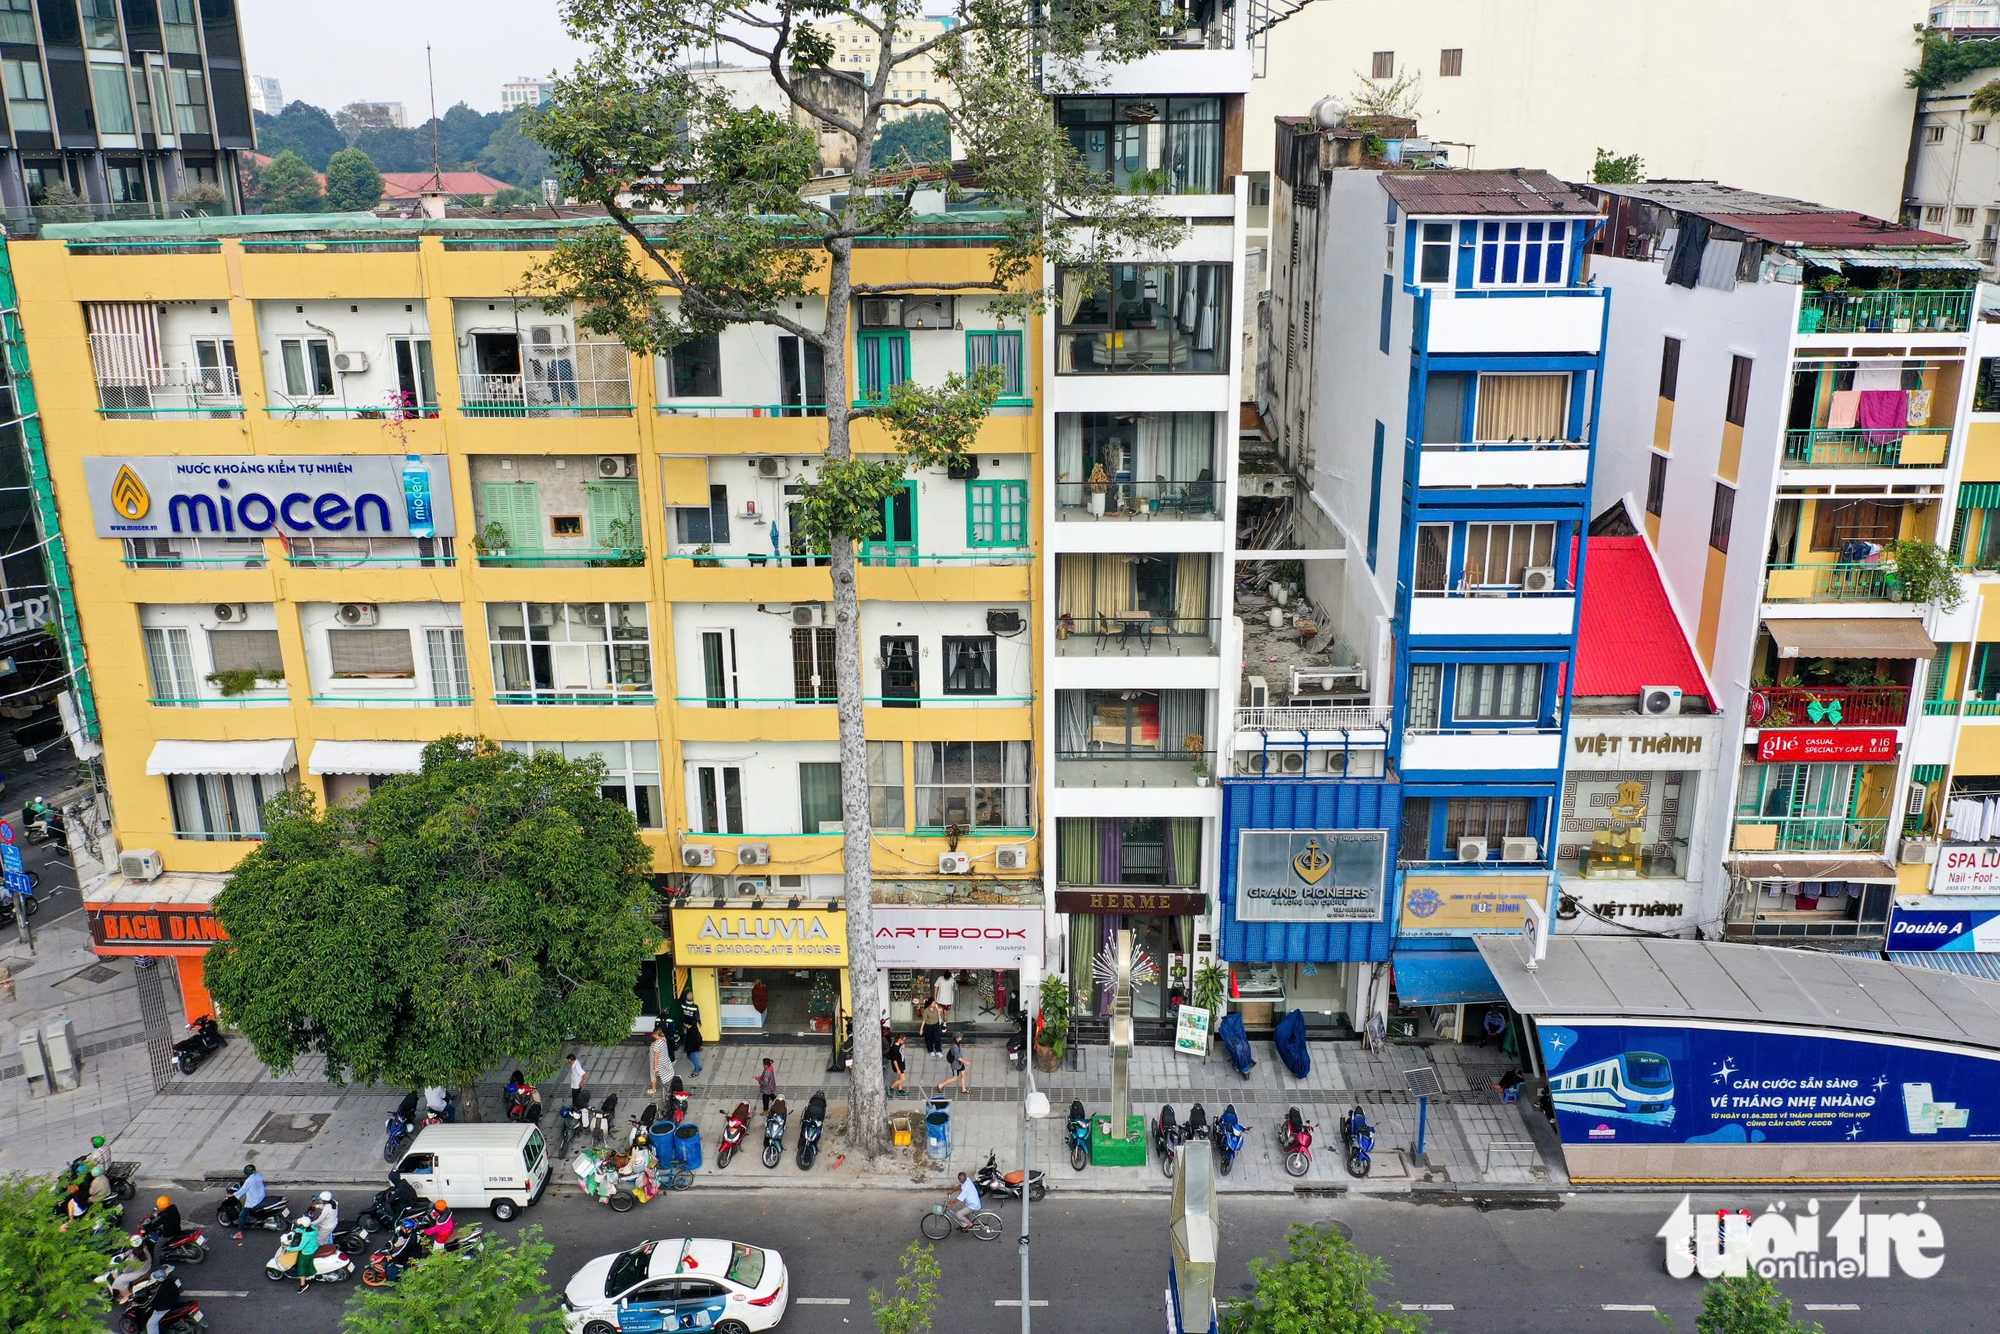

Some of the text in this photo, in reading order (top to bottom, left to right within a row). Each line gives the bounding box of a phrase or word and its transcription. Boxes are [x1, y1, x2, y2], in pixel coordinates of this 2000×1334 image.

[177, 463, 211, 474] NƯỚC
[214, 462, 265, 474] KHOÁNG
[298, 463, 314, 475] TỰ
[316, 461, 353, 474] NHIÊN
[168, 478, 393, 532] miocen
[412, 476, 426, 520] miocen
[1575, 732, 1702, 757] VIỆT THÀNH
[1845, 745, 1864, 753] CAFÉ
[1879, 738, 1890, 746] 16
[1947, 852, 1976, 868] SPA
[1948, 872, 1993, 883] Nail Foot
[1248, 887, 1369, 899] GRAND PIONEERS
[1090, 894, 1171, 909] HERME
[1594, 900, 1684, 919] VIỆT THÀNH
[104, 915, 162, 939] BACH
[699, 915, 829, 940] ALLUVIA
[876, 927, 1026, 938] ARTBOOK
[1893, 922, 1963, 934] Double A
[686, 944, 841, 955] THE CHOCOLATE HOUSE
[1733, 1077, 1859, 1089] CĂN CƯỚC SẴN SÀNG
[1710, 1093, 1876, 1110] VÉ THÁNG NHẸ NHÀNG
